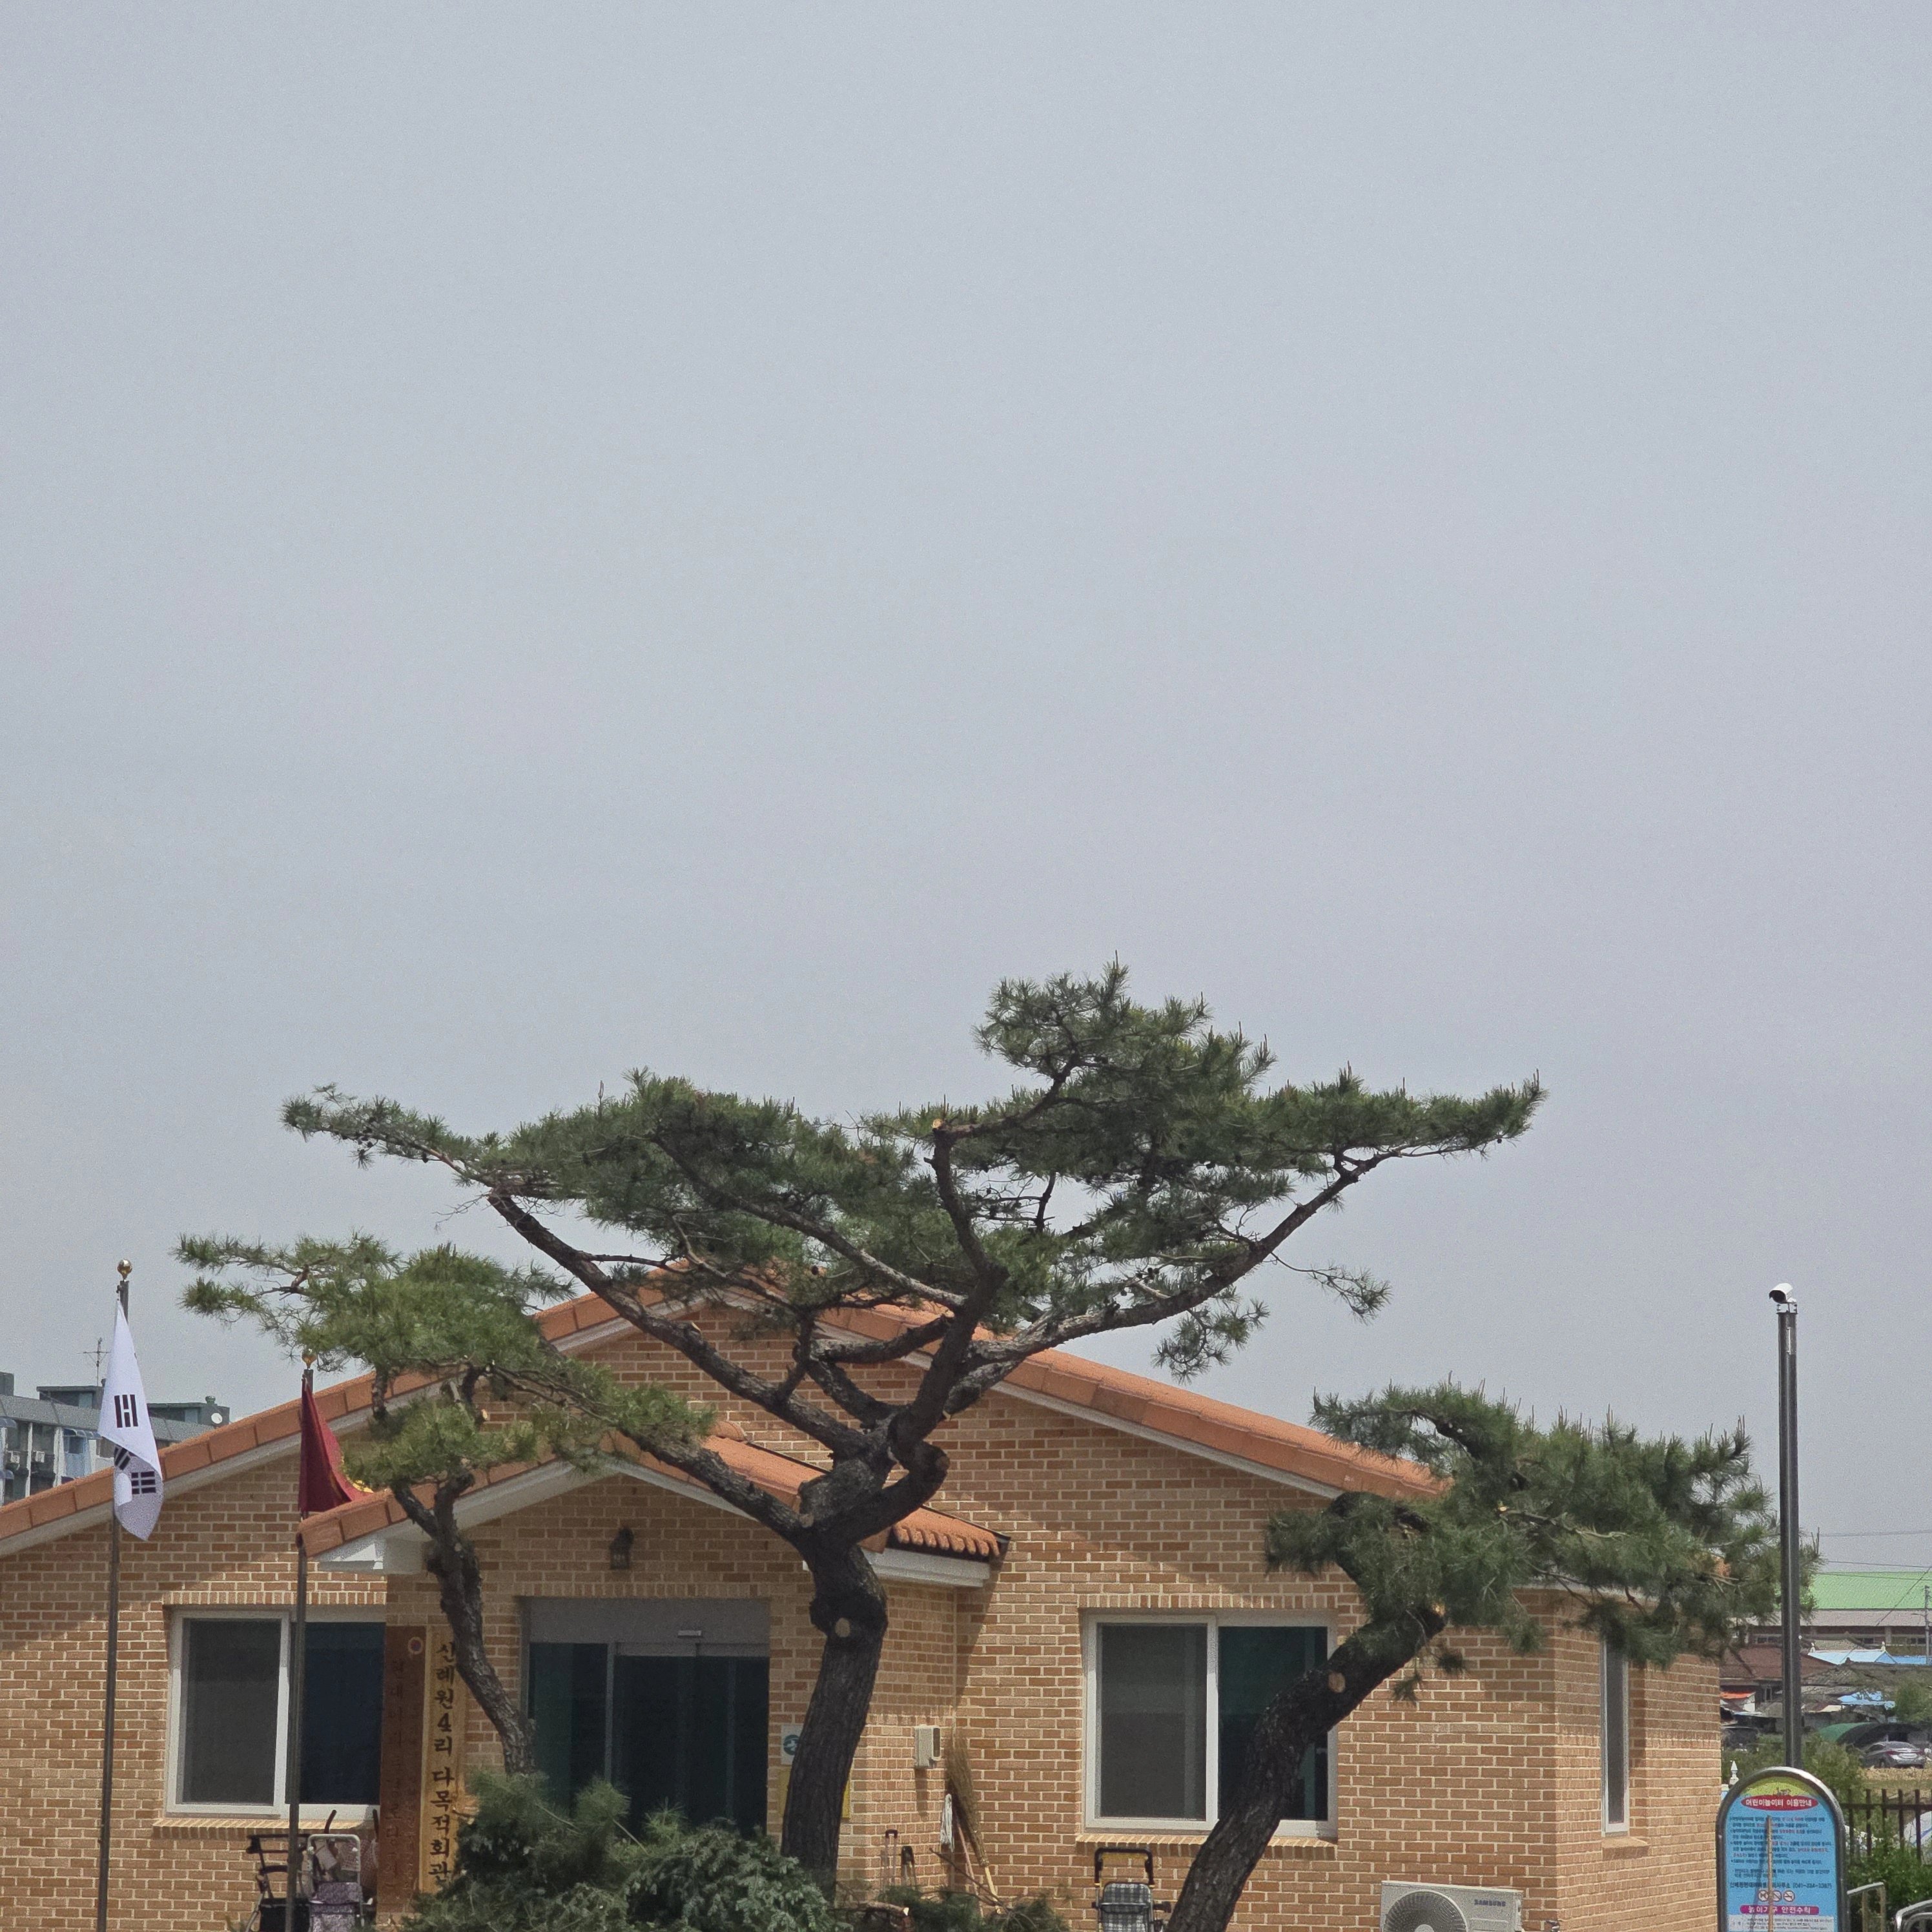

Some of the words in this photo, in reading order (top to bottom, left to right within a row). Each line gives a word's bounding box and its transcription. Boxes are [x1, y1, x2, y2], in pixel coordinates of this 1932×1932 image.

[1745, 1798, 1783, 1807] 어린이놀이터
[1787, 1798, 1812, 1807] 이용안내
[428, 1766, 455, 1885] 다목적회관
[1474, 1899, 1506, 1907] SAMSUNG
